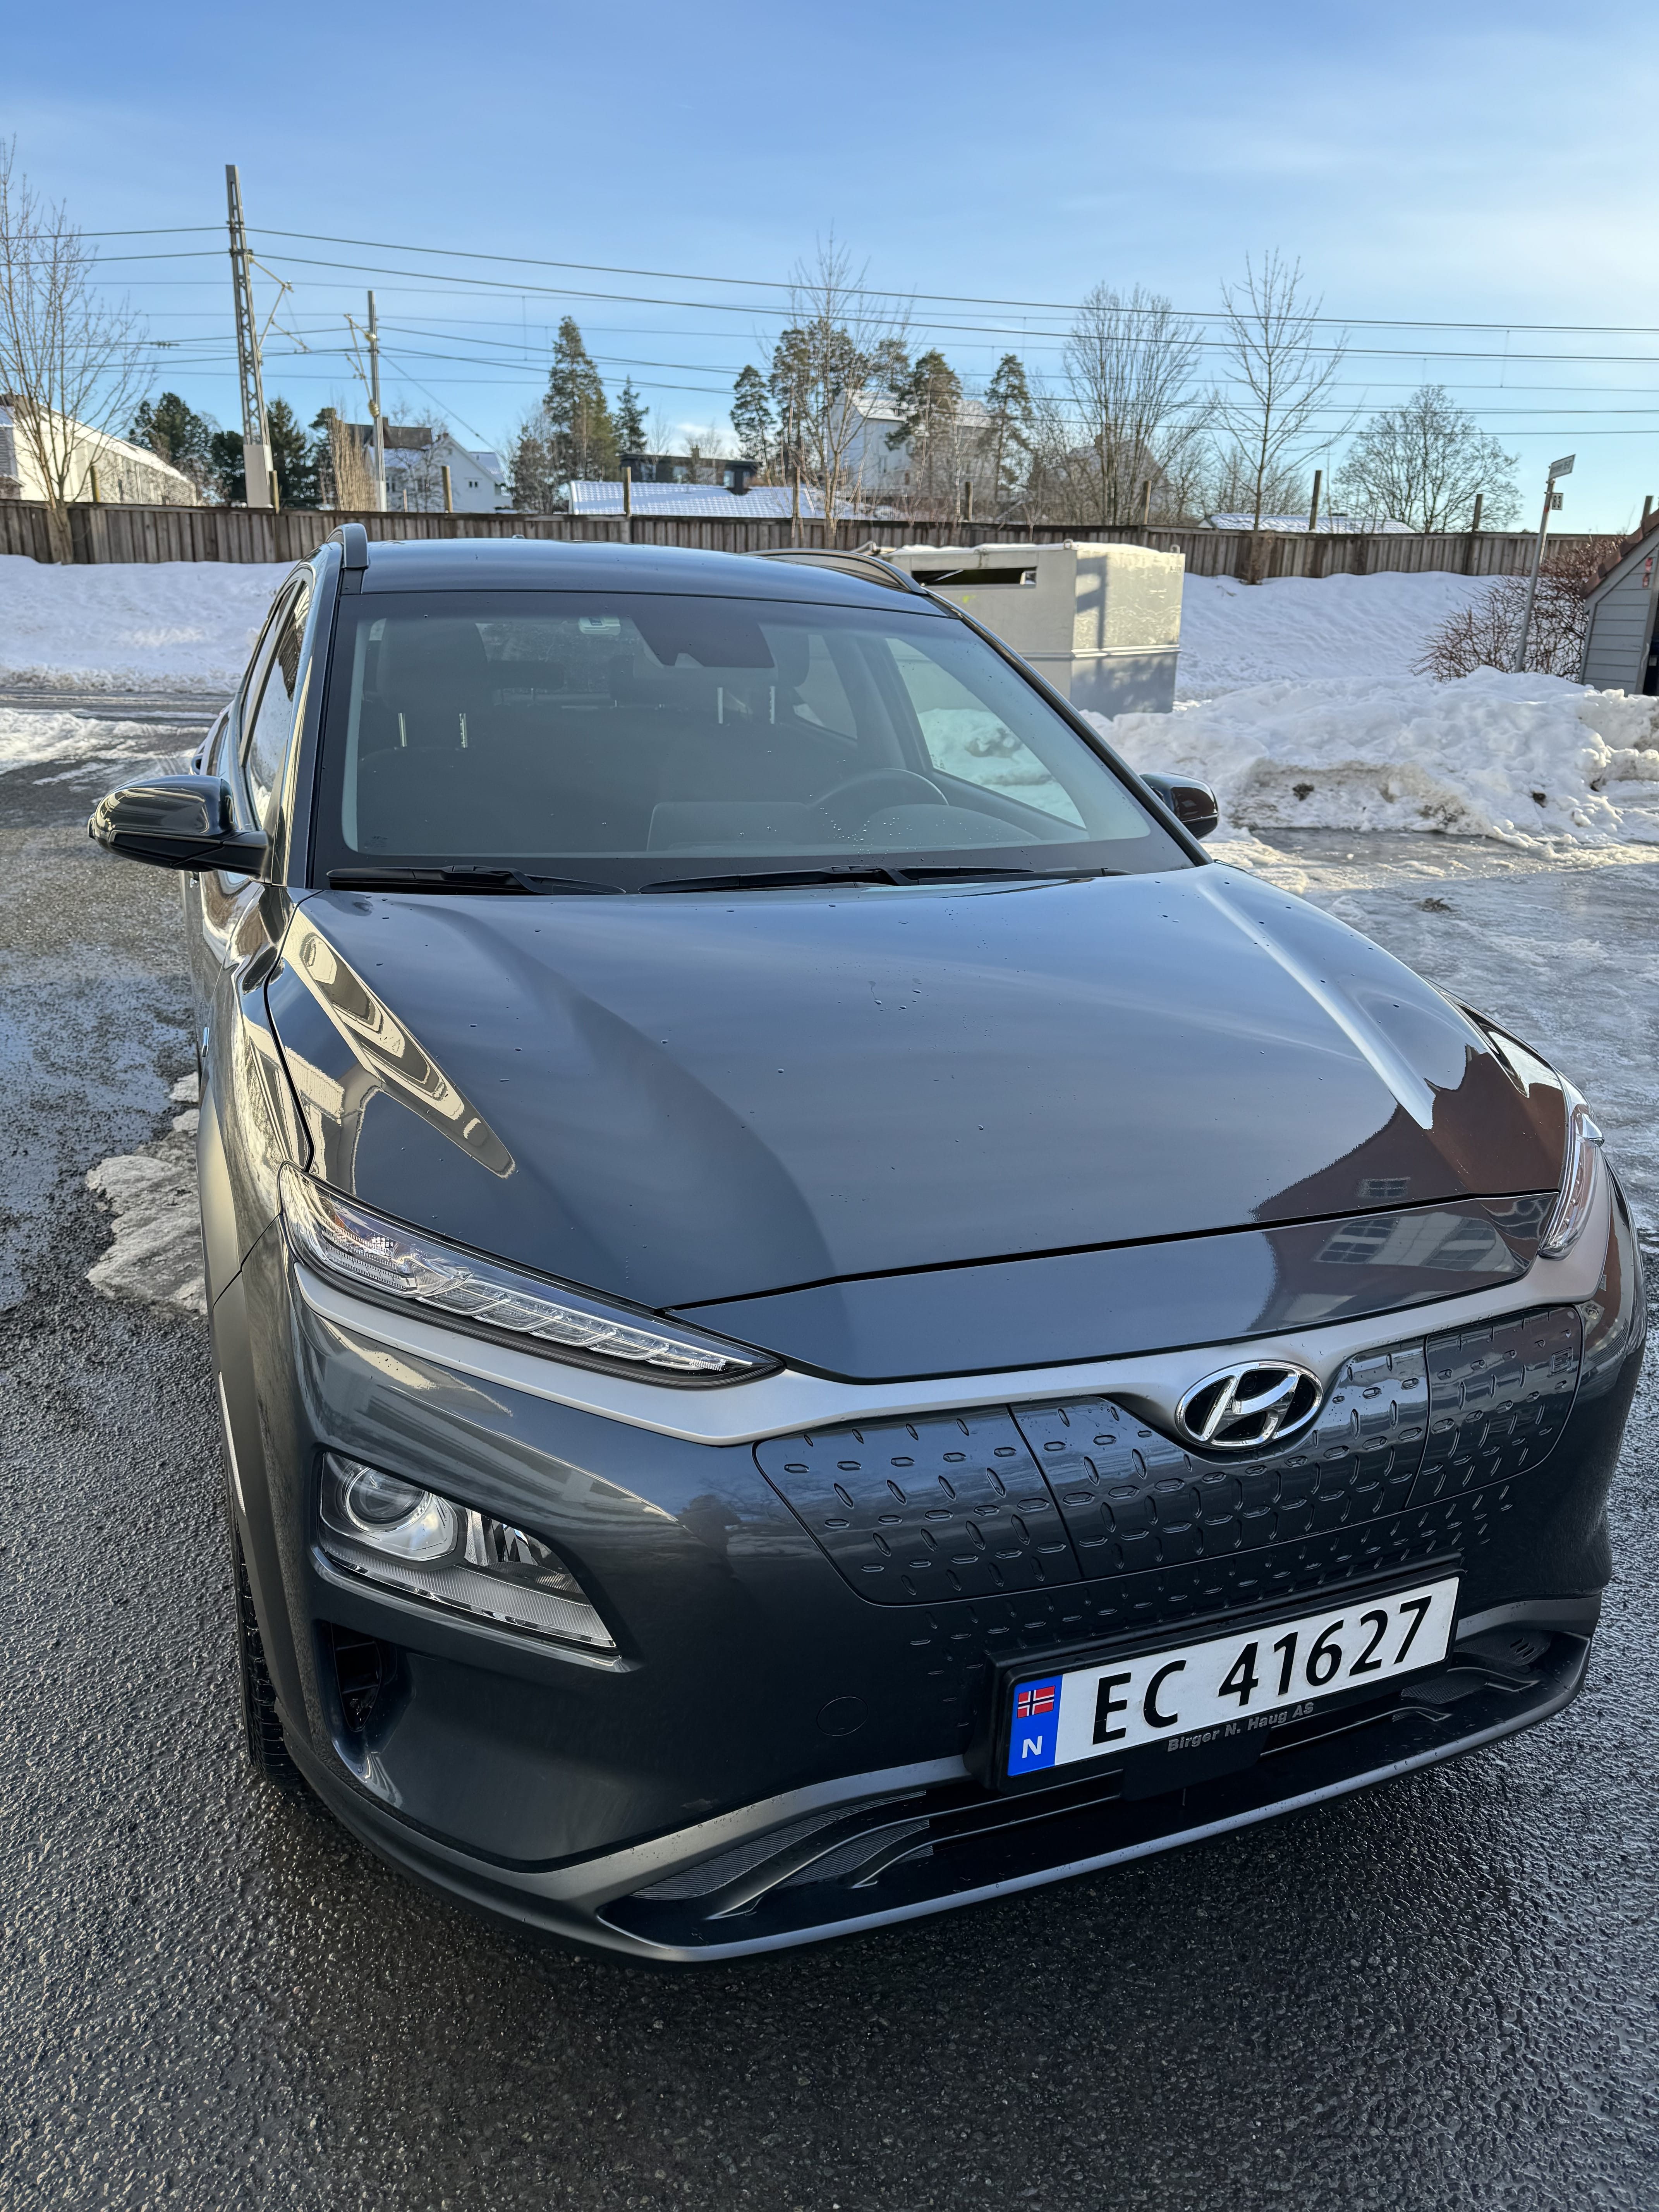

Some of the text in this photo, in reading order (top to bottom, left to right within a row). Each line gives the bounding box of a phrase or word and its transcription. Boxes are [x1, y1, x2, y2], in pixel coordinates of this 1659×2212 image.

[1092, 1595, 1432, 1745] EC 41627
[1022, 1735, 1043, 1759] N
[1167, 1702, 1314, 1752] Birger N. Haug AS
